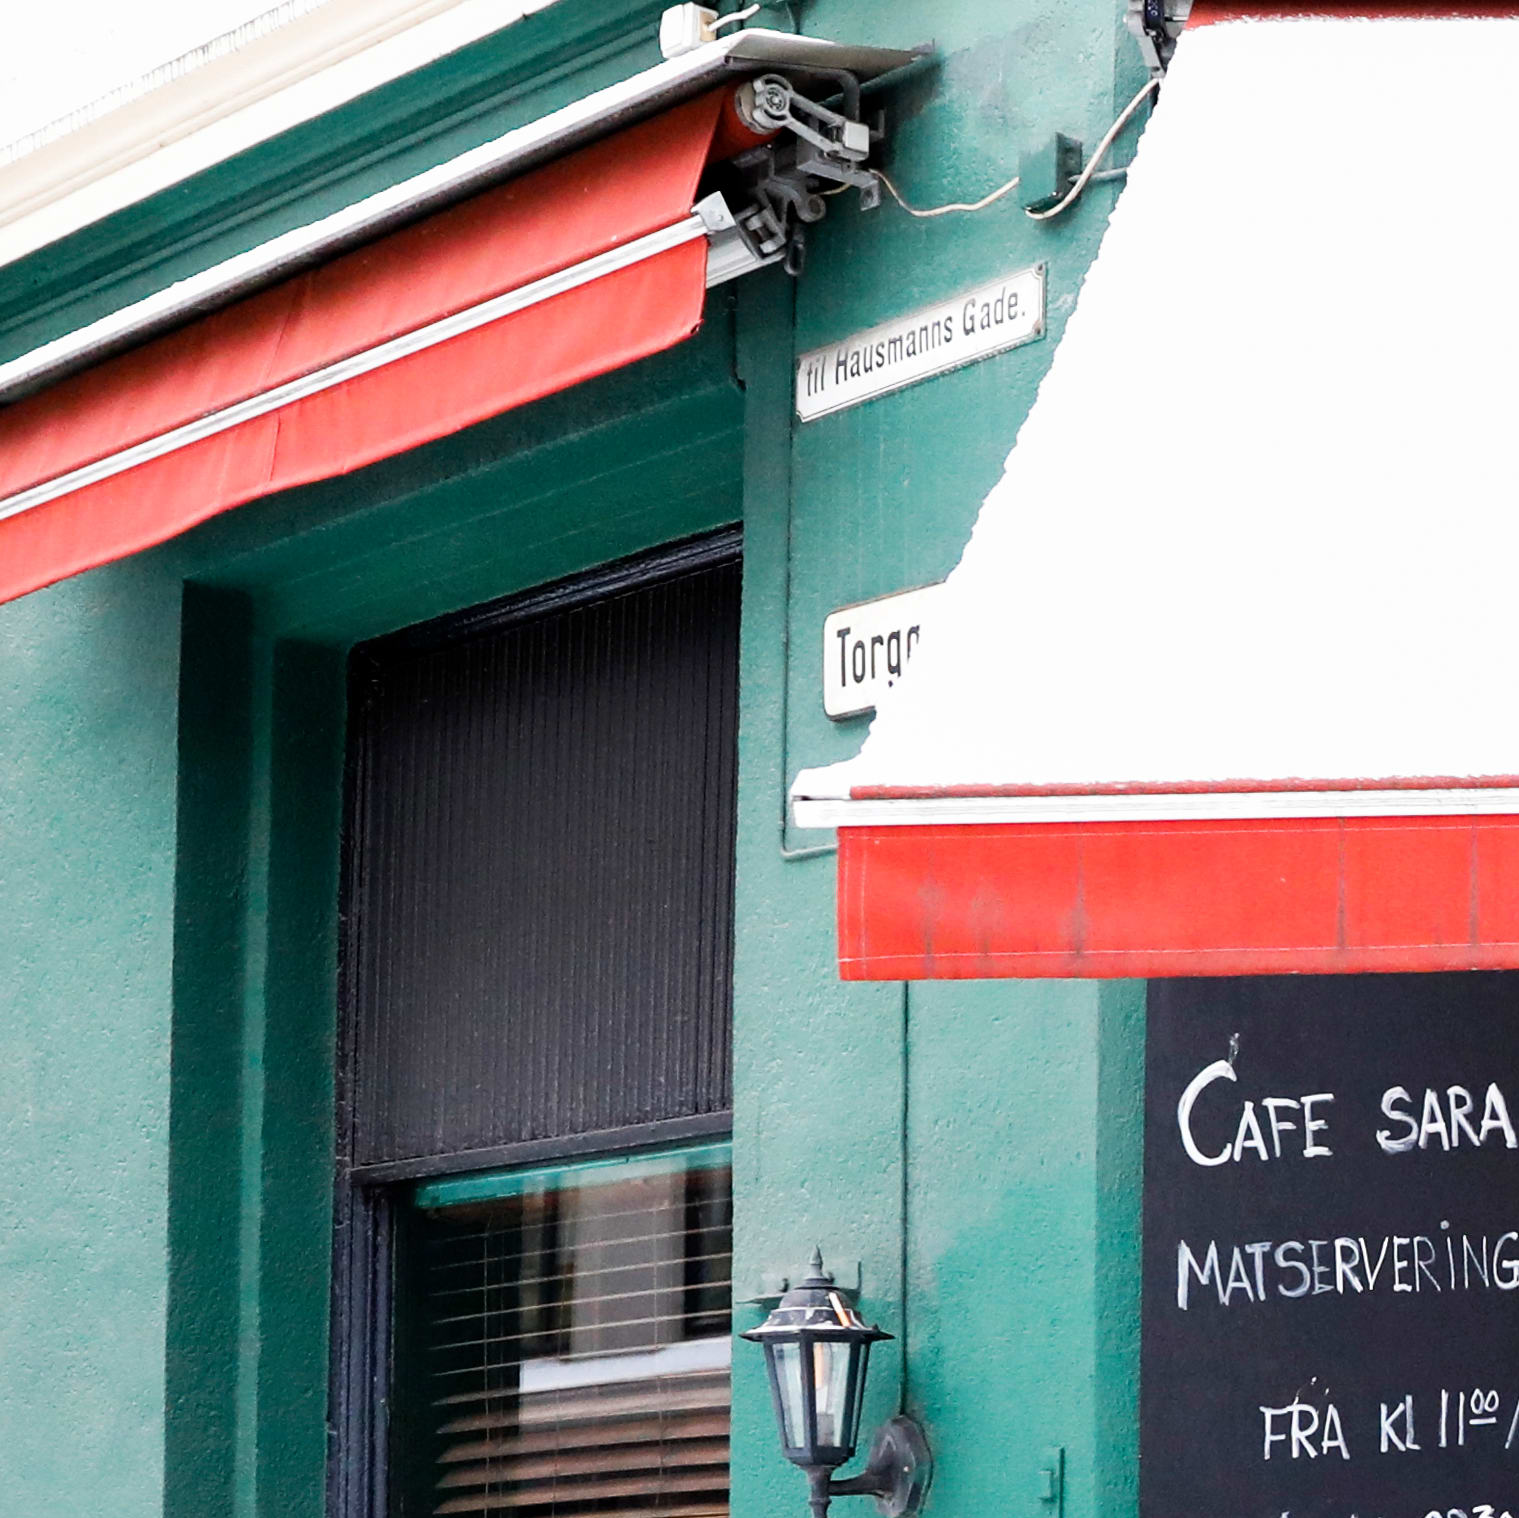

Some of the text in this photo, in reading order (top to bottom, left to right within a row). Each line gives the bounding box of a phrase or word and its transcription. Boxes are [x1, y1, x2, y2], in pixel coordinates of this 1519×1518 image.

[806, 286, 1026, 397] til Hausmanns Gade.
[1375, 1082, 1519, 1155] SARA
